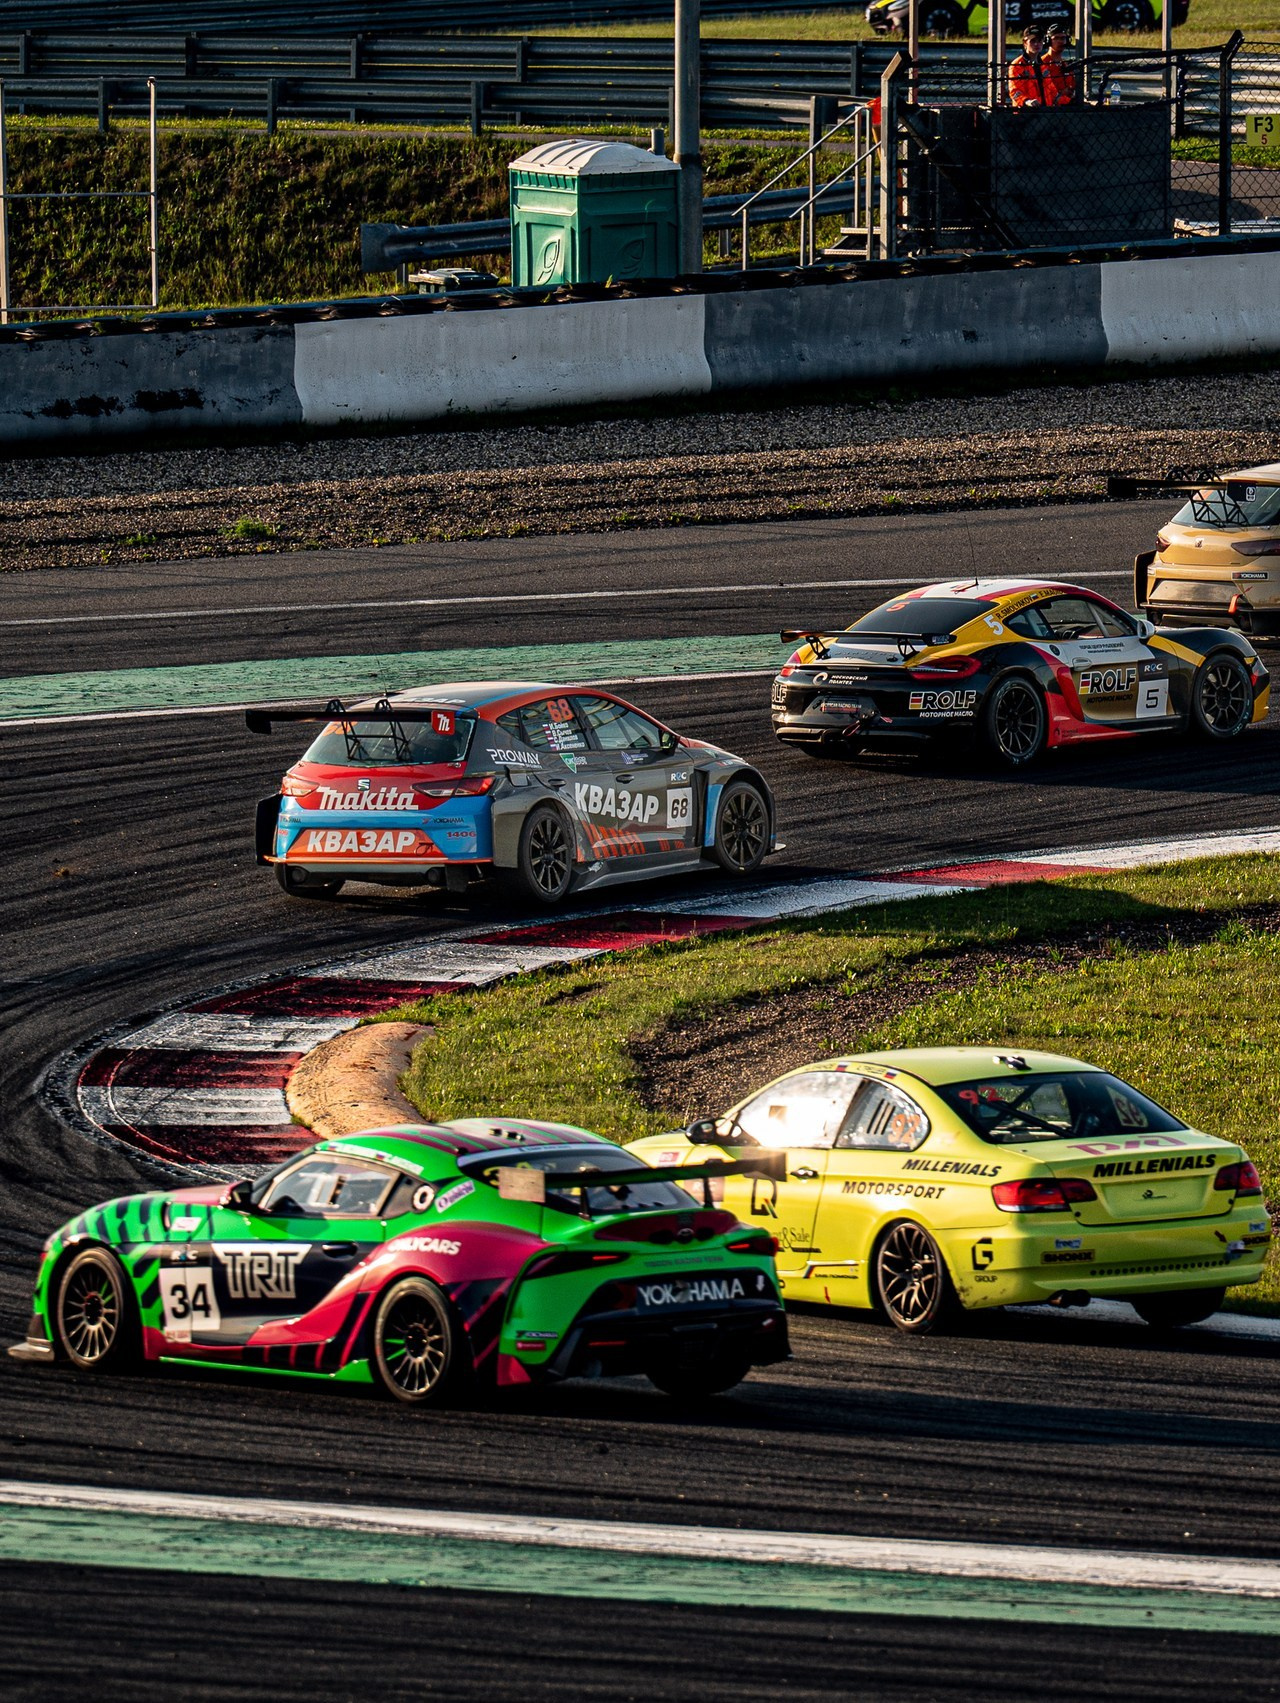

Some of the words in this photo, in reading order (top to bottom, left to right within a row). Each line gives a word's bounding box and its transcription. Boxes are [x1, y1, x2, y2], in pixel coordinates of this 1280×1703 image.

[1253, 116, 1274, 133] F3
[1261, 133, 1268, 145] 5
[983, 614, 1004, 635] 5
[1089, 667, 1137, 693] ROLF
[921, 689, 977, 710] ROLF
[1145, 688, 1160, 709] 5
[546, 698, 575, 722] 68
[486, 748, 541, 765] PROWAY
[574, 782, 660, 824] КВАЗАР
[671, 798, 689, 819] 68
[307, 830, 416, 853] КВАЗАР
[958, 1086, 1004, 1106] 92
[887, 1113, 921, 1143] 92
[902, 1158, 1002, 1177] MILLENIALS
[1093, 1154, 1217, 1178] MILLENIALS
[842, 1181, 945, 1199] MOTORSPORT
[170, 1284, 212, 1319] 34
